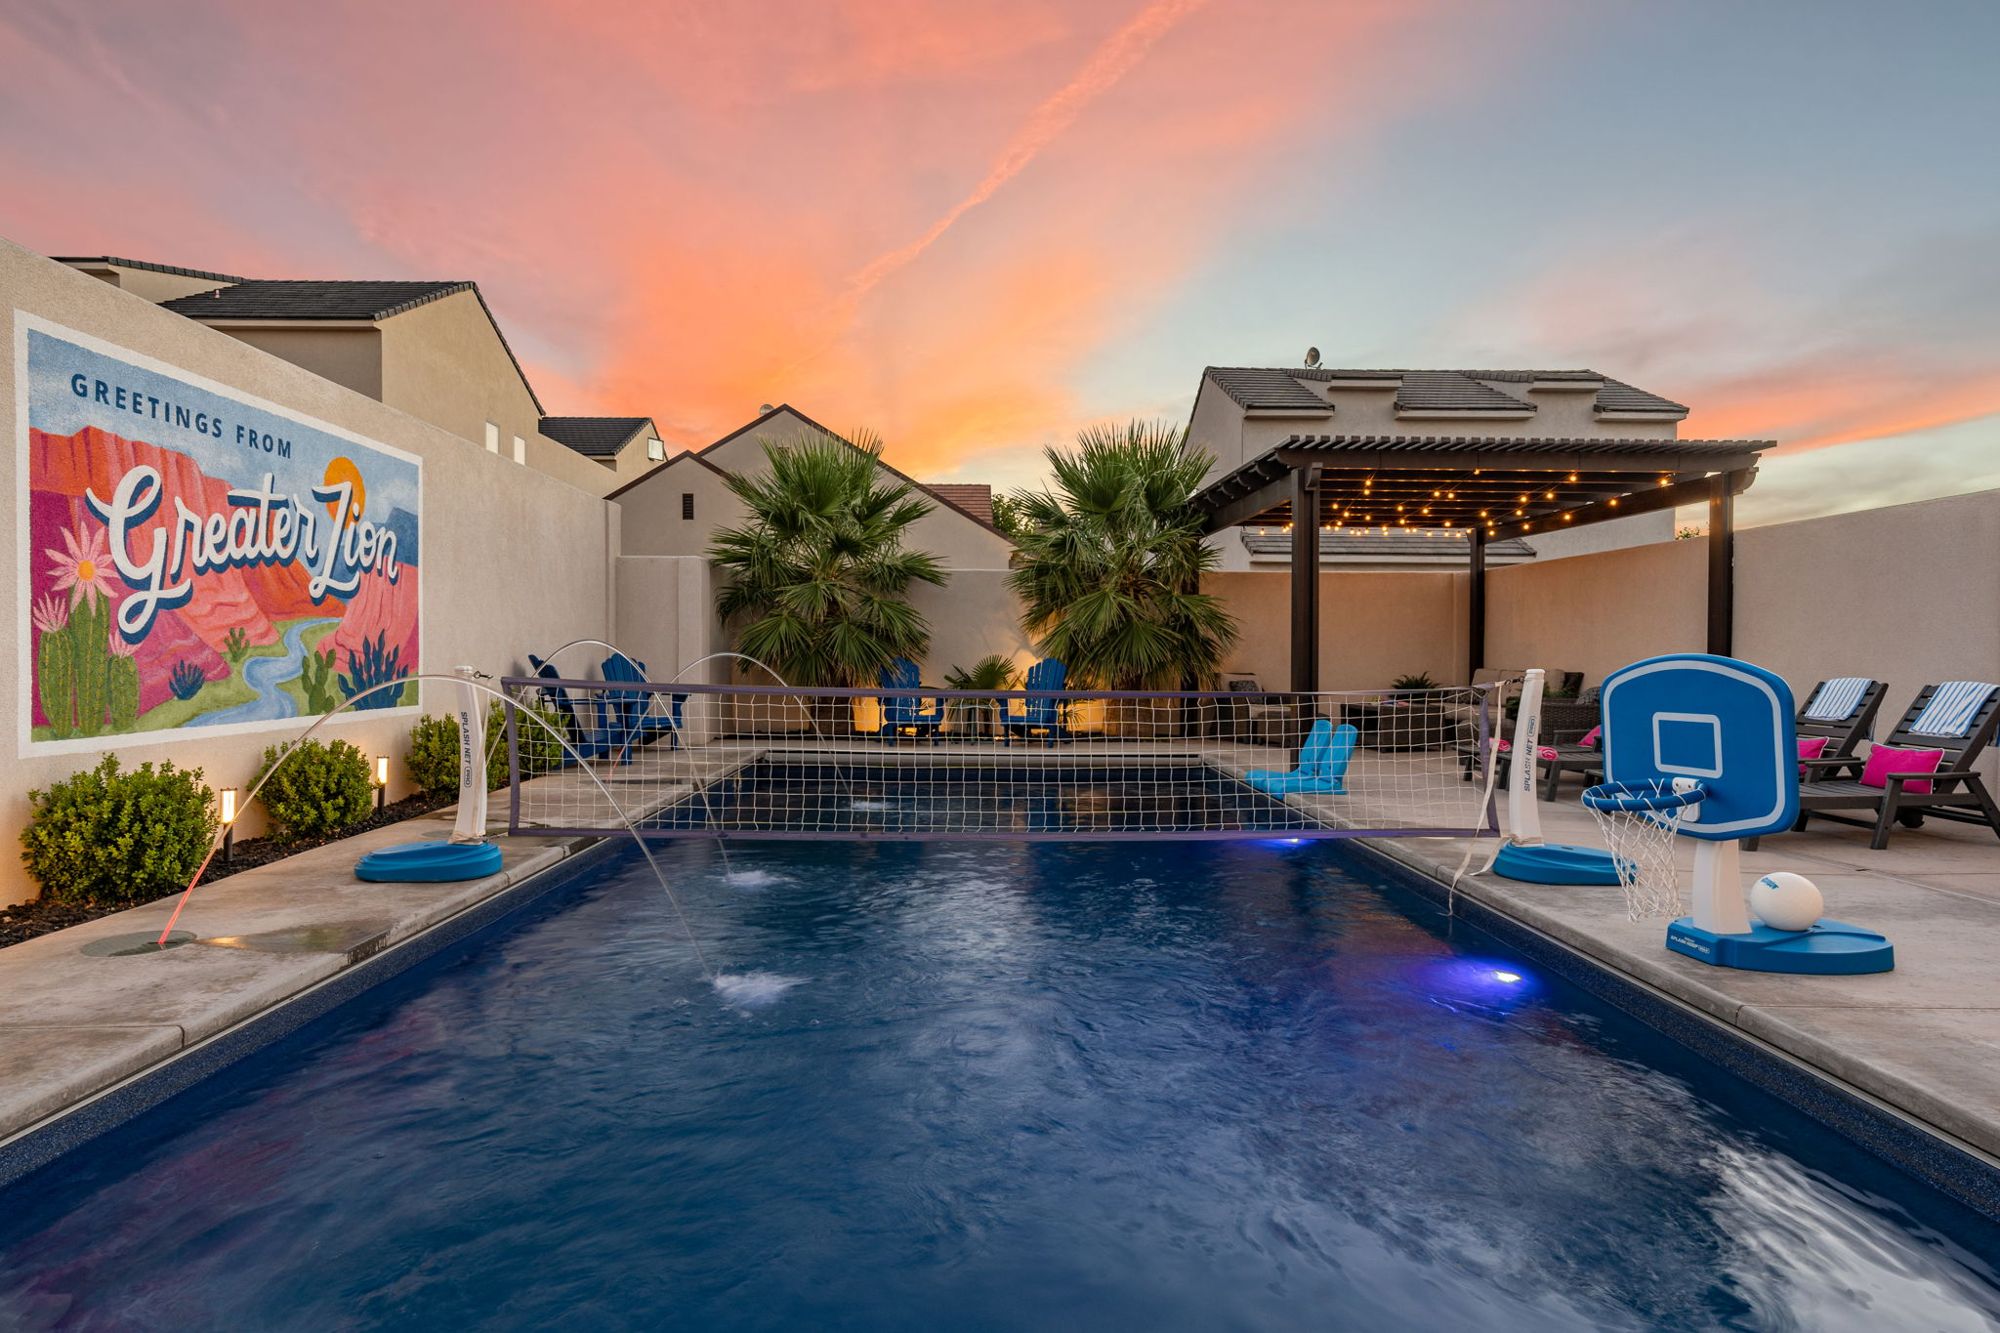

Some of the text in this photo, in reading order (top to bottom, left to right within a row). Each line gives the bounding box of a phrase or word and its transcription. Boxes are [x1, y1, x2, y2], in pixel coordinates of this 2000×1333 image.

[71, 373, 292, 459] GREETINGS FROM
[85, 465, 399, 644] Greater Zion
[461, 711, 471, 746] SPLASH
[464, 747, 472, 765] NET
[1525, 738, 1533, 756] NET
[1523, 757, 1531, 792] SPLASH
